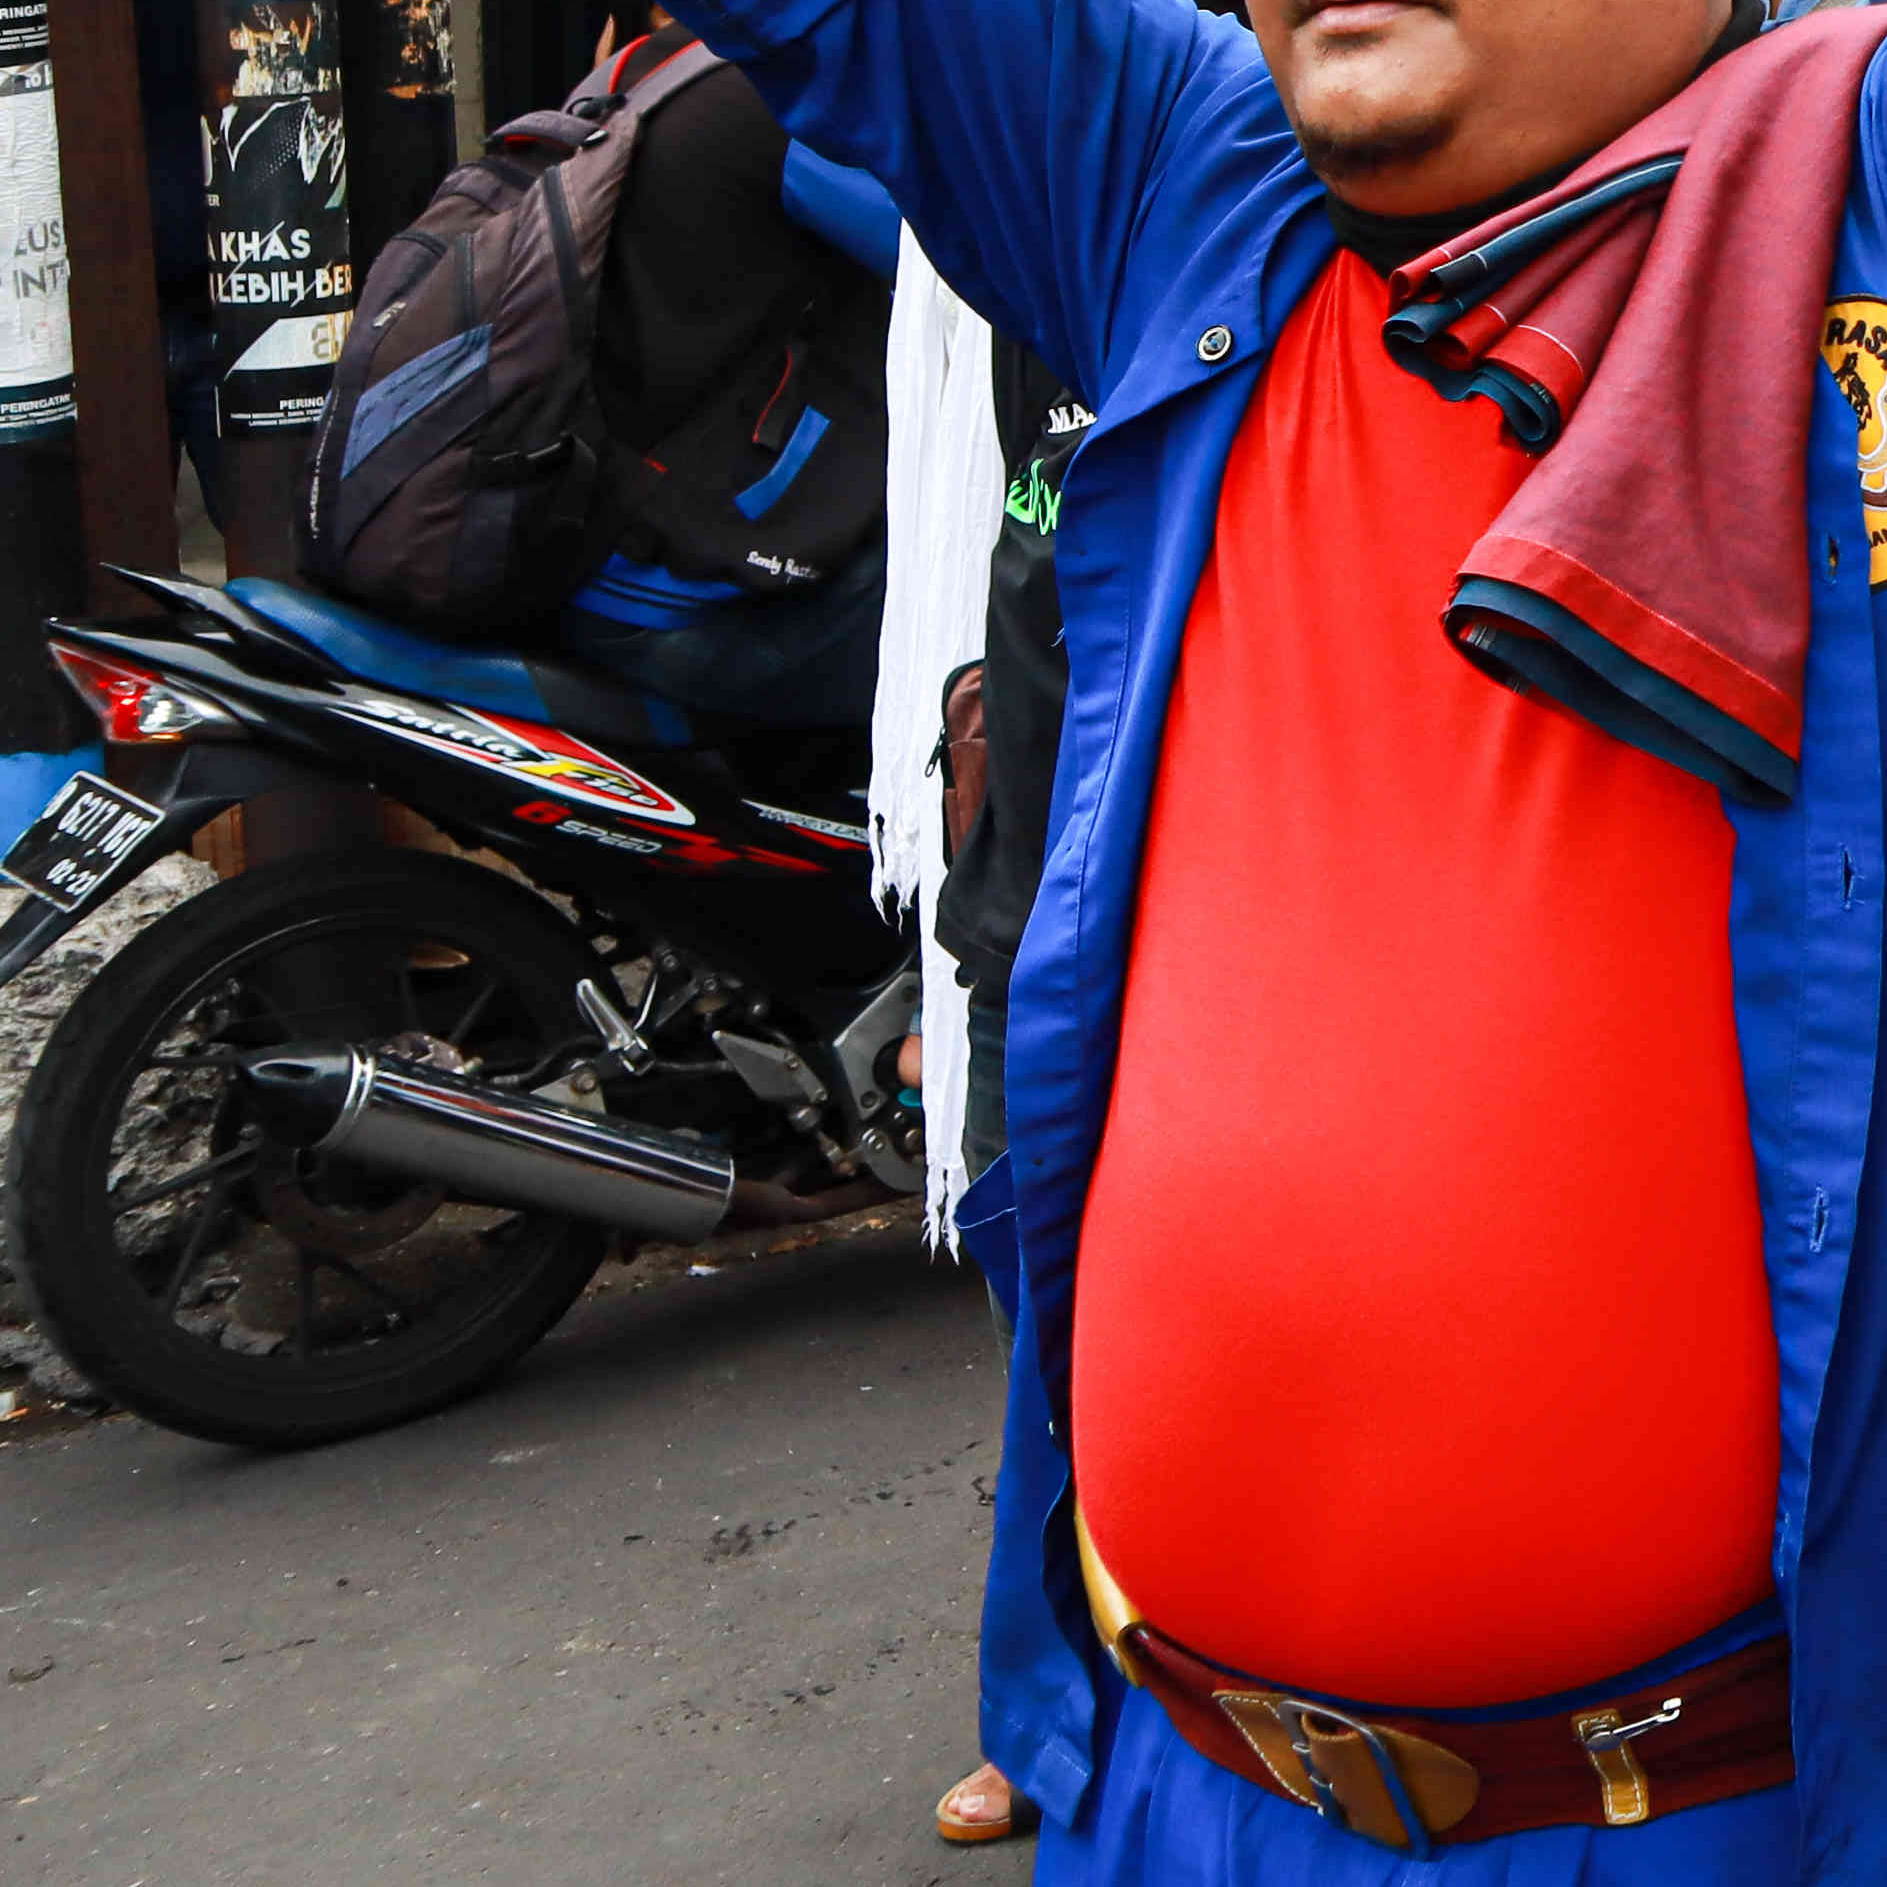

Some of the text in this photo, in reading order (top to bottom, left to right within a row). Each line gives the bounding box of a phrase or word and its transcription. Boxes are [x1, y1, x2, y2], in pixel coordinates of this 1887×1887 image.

[220, 227, 311, 262] KHAS
[217, 270, 305, 304] LEBIH
[57, 791, 122, 842] 6217
[555, 819, 663, 854] SPEED
